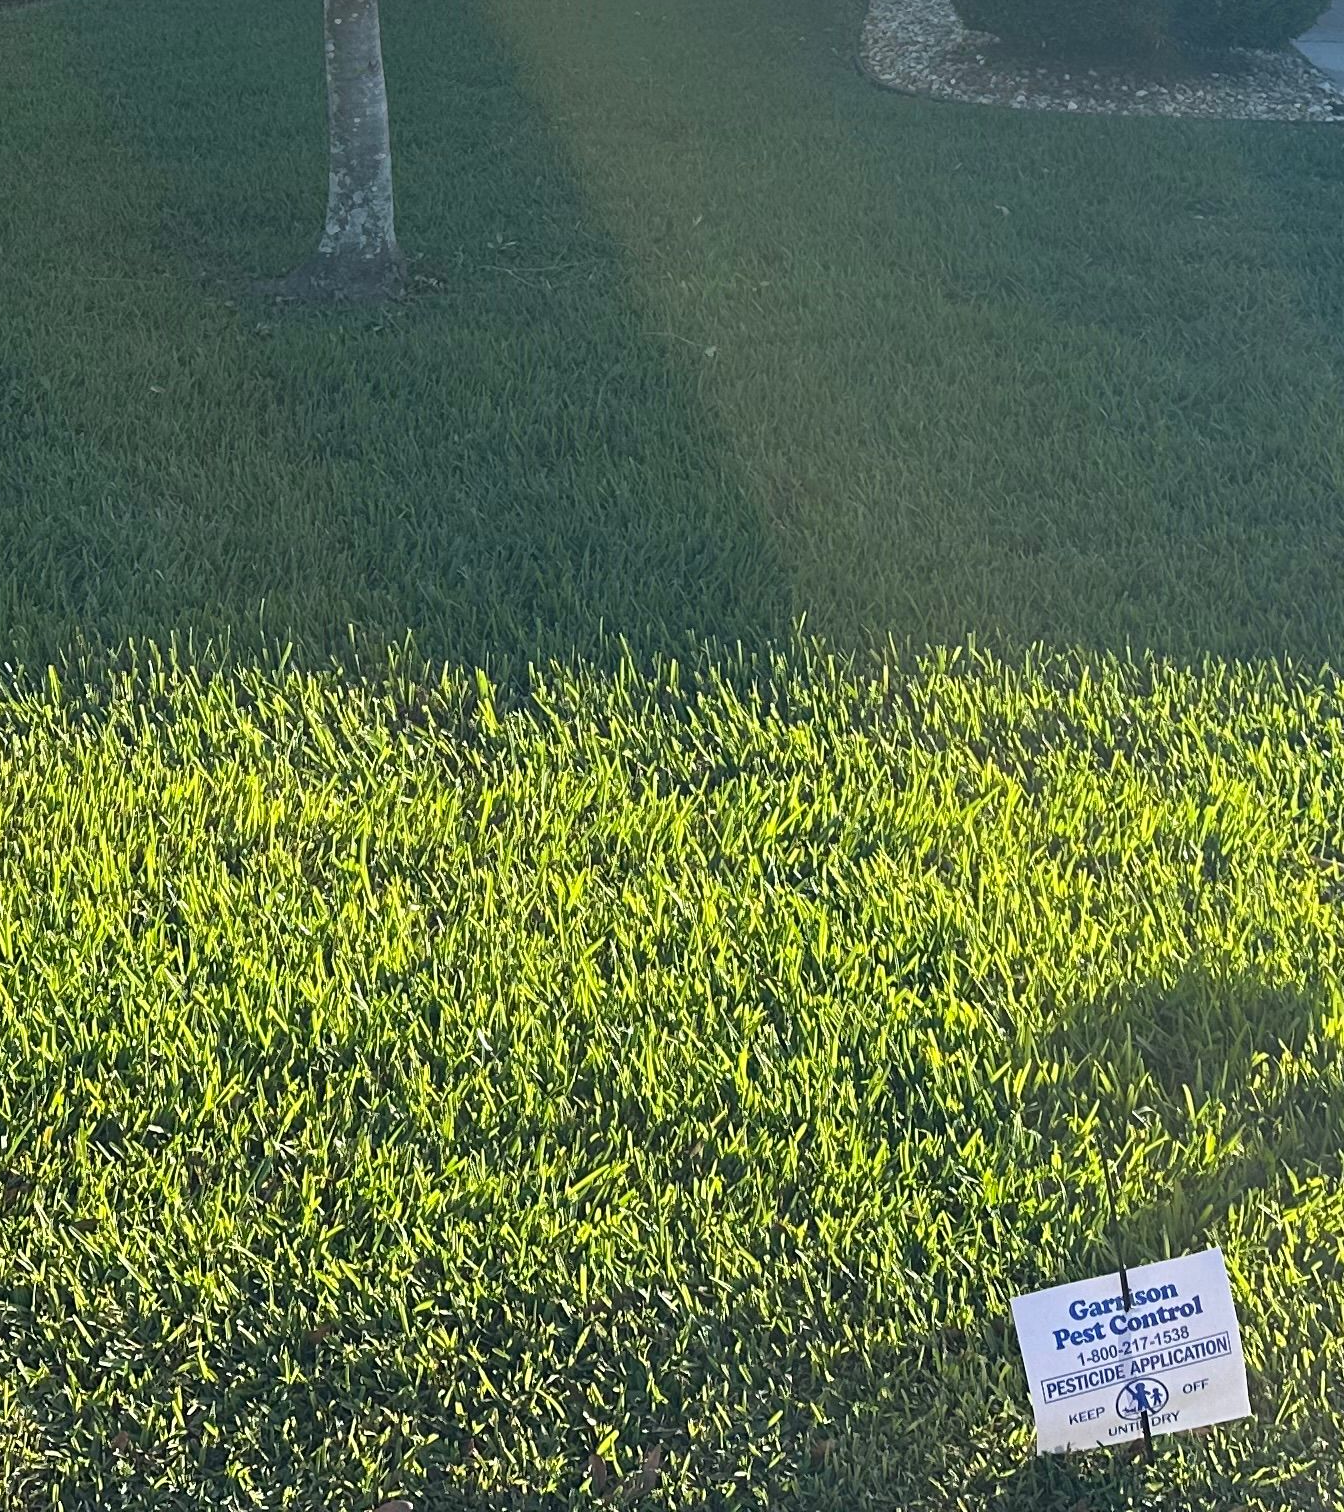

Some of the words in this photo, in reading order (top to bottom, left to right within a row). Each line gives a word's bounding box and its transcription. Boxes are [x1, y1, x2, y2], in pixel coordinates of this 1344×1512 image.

[1053, 1322, 1106, 1350] Pest
[1109, 1295, 1203, 1335] Control
[1046, 1364, 1125, 1399] PESTICIDE
[1130, 1337, 1228, 1376] APPLICATION
[1077, 1326, 1190, 1367] 1-800-217-1538
[1068, 1406, 1105, 1425] KEEP
[1182, 1378, 1209, 1395] OFF
[1151, 1410, 1180, 1427] DRY
